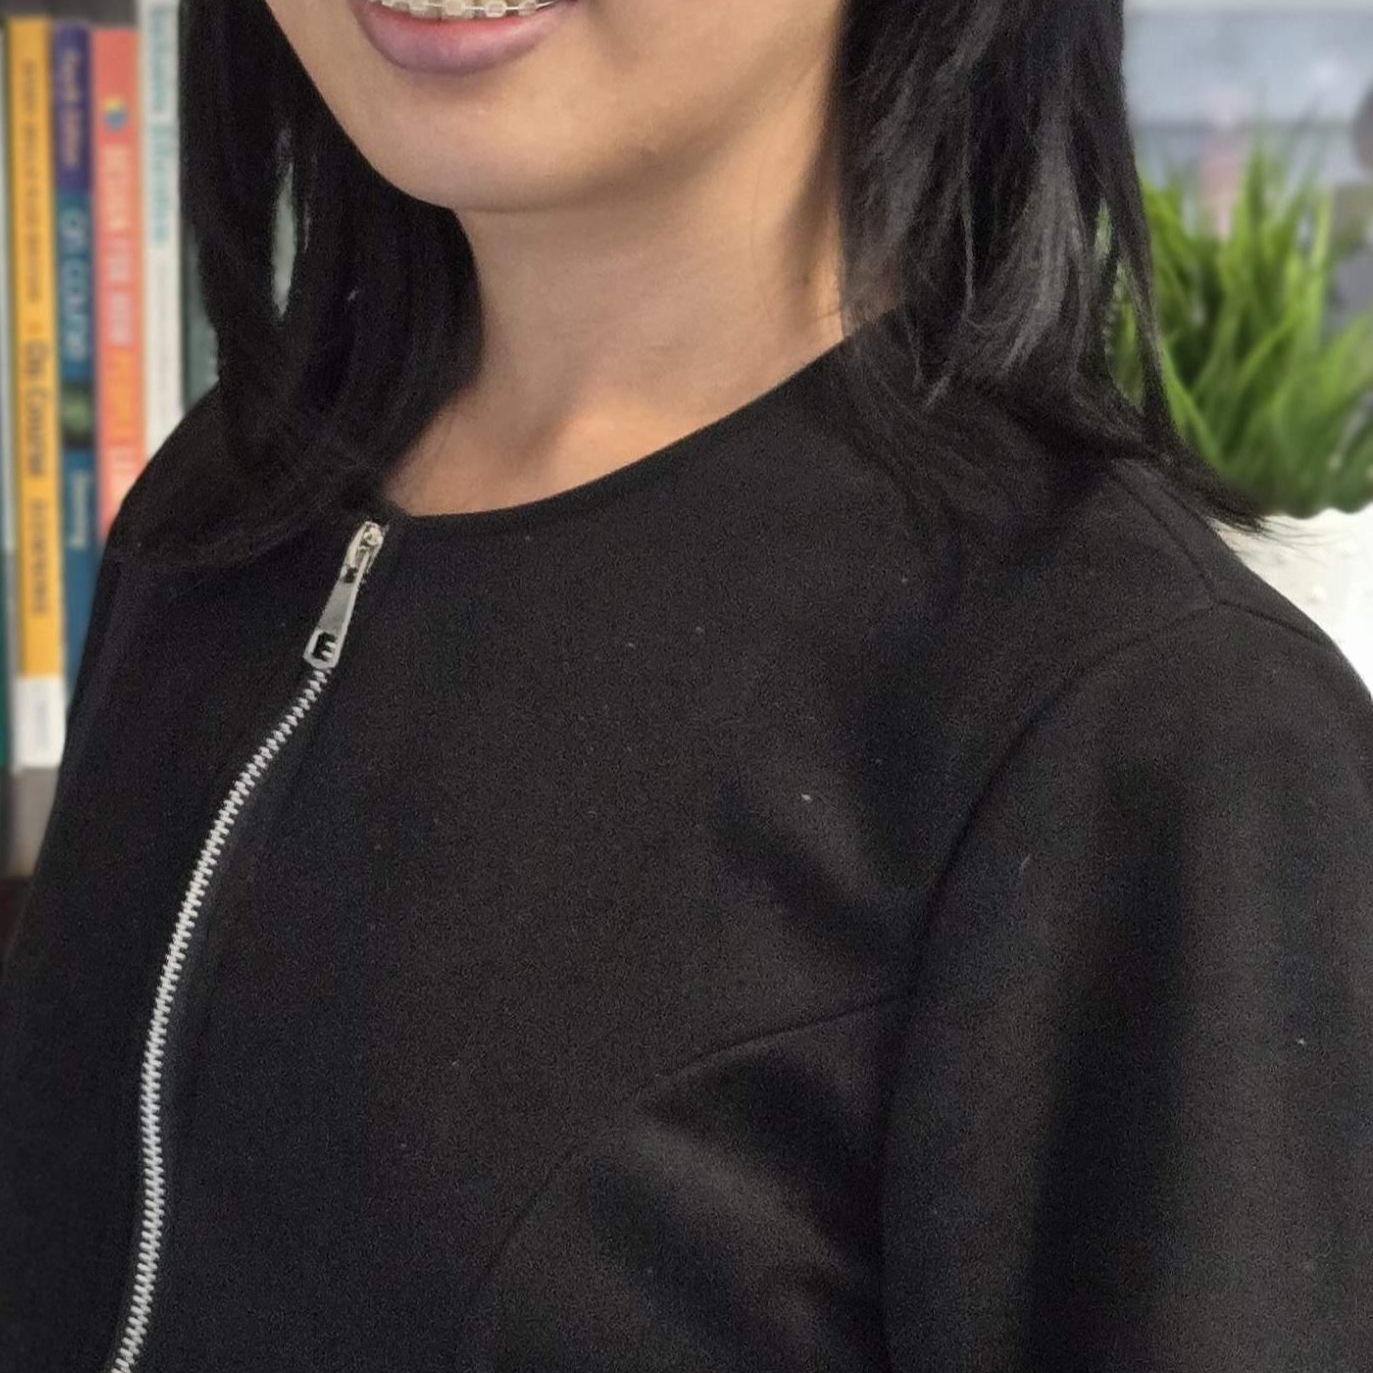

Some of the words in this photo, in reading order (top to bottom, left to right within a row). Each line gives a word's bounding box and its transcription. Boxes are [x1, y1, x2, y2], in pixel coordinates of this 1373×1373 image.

[62, 210, 88, 254] on
[64, 258, 91, 361] course
[30, 497, 50, 617] DOWNING
